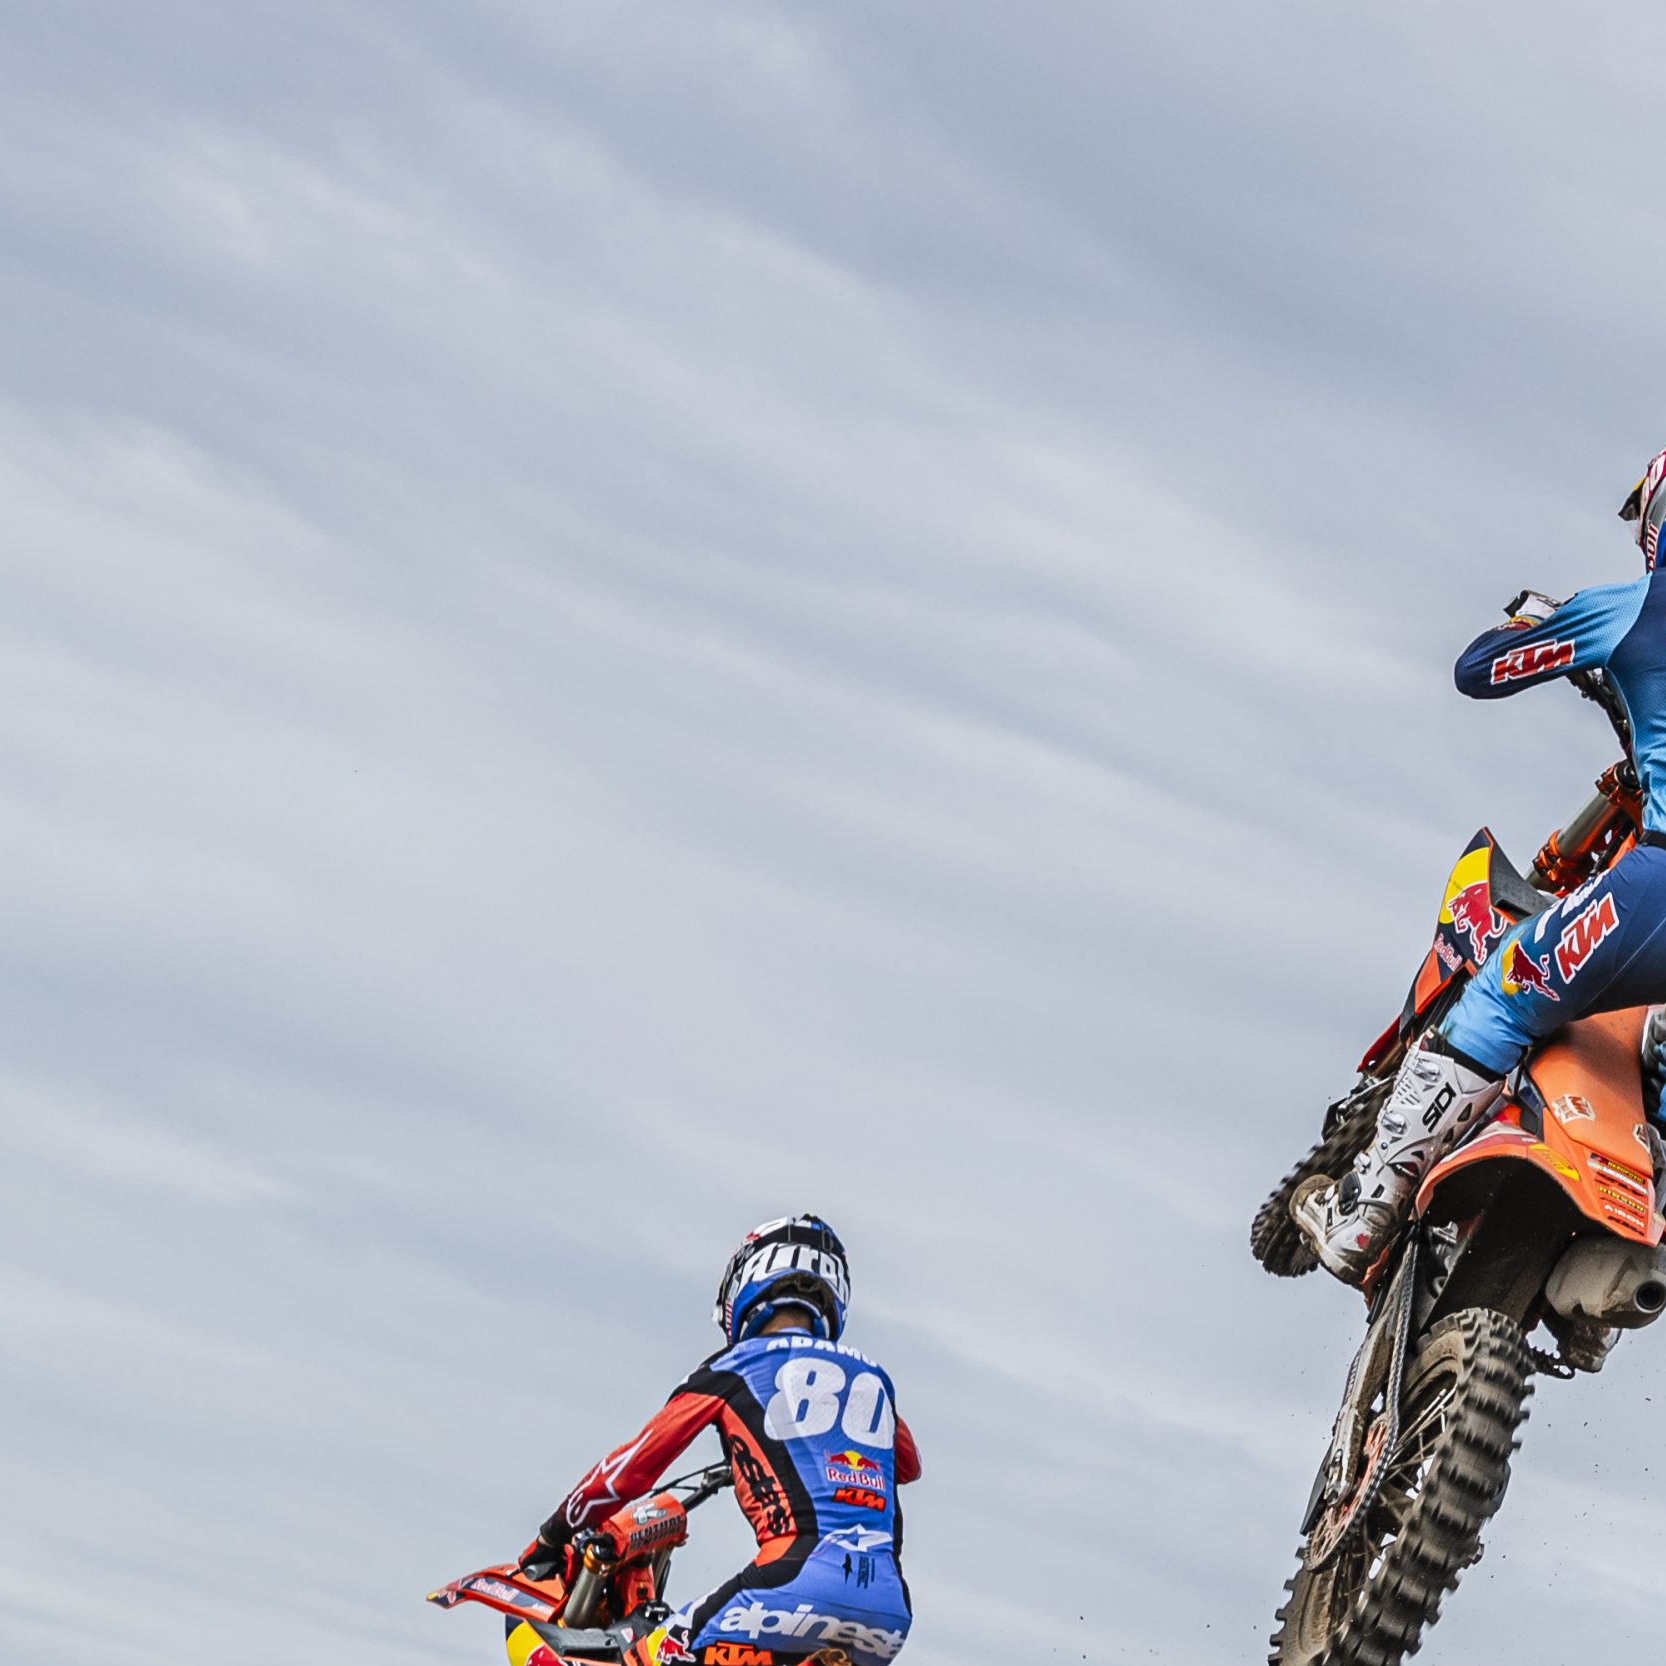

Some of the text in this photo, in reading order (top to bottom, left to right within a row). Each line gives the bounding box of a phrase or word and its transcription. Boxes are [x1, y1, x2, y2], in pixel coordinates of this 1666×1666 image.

[1491, 639, 1575, 685] KTM
[1554, 891, 1620, 984] KTM
[765, 1358, 897, 1450] 80
[826, 1467, 886, 1491] Red Bull
[833, 1486, 886, 1512] KTM
[704, 1642, 773, 1666] KTM
